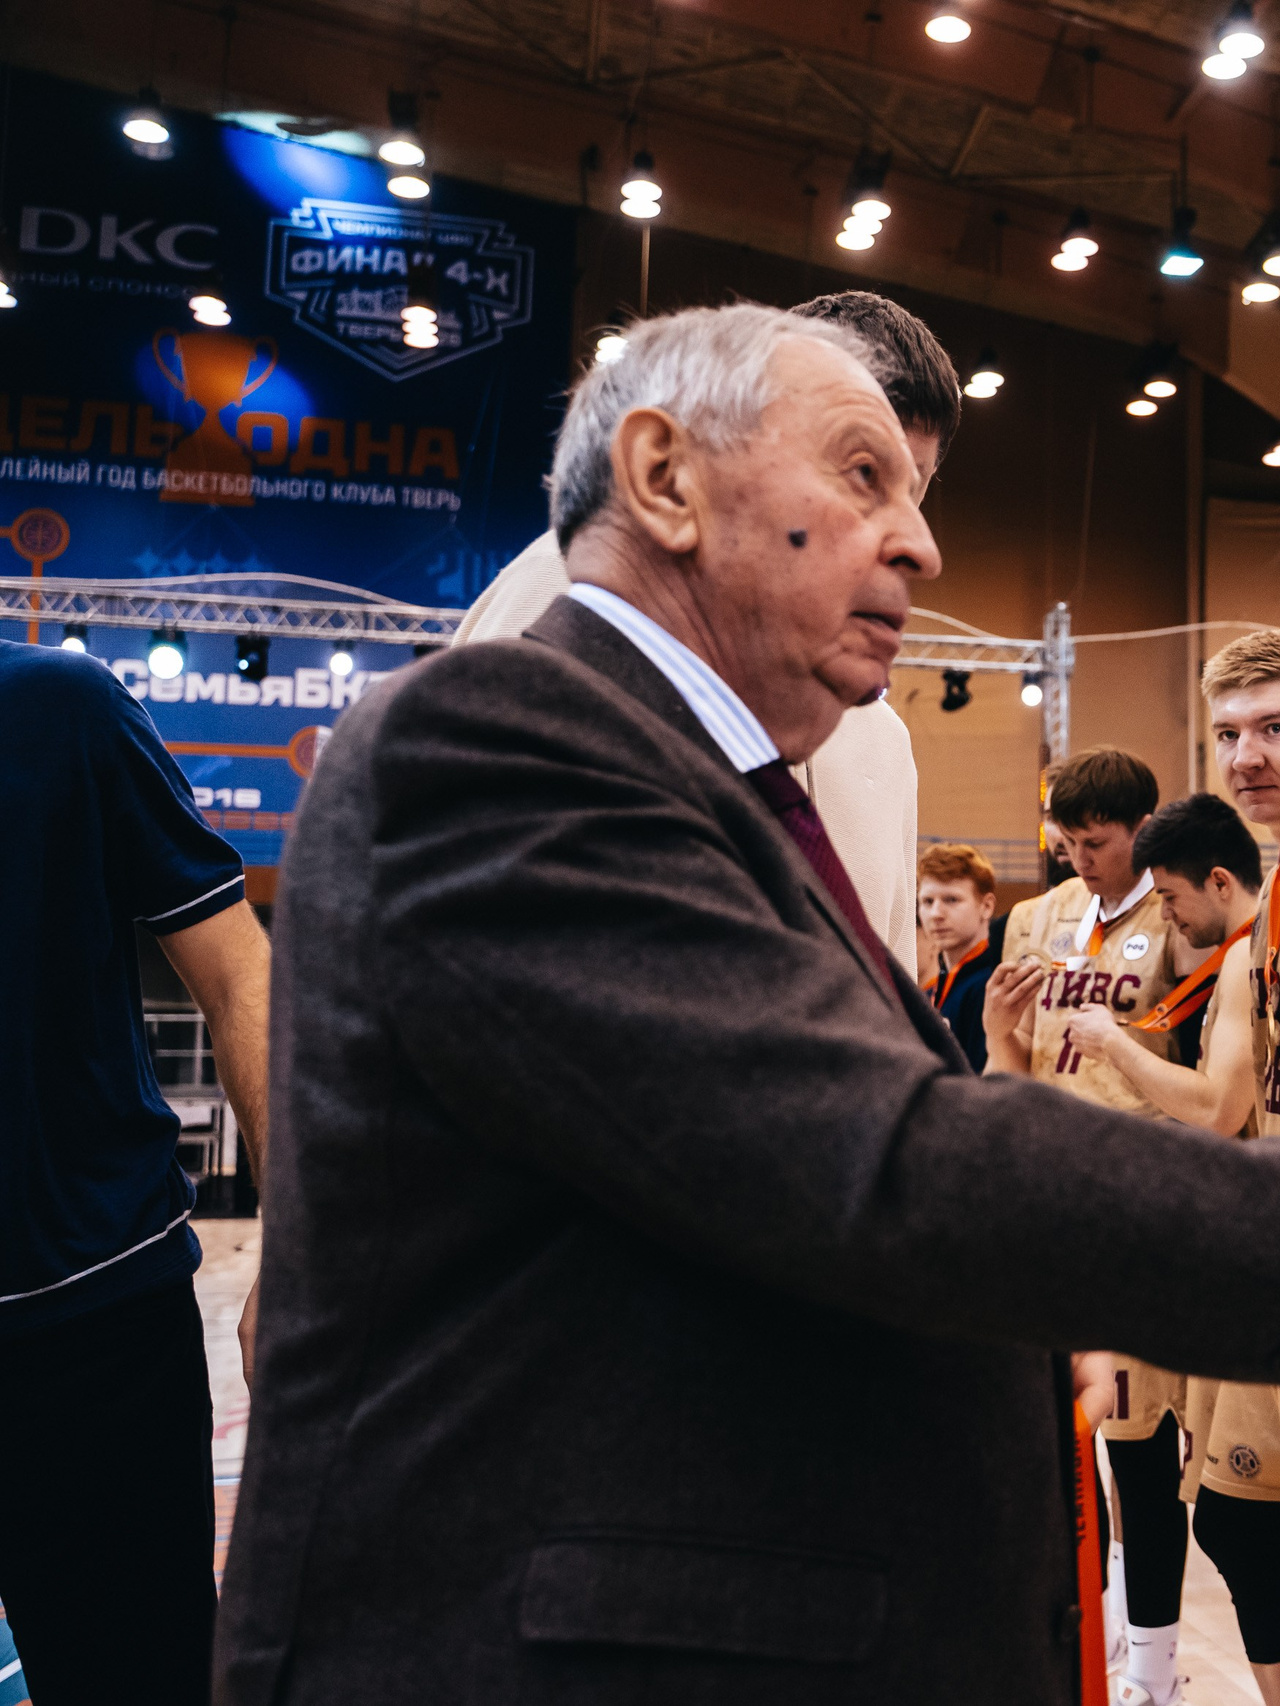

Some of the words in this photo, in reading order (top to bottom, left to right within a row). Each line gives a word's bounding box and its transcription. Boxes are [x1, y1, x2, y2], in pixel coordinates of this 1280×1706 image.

[18, 206, 220, 271] DKC
[236, 411, 461, 480] ОДНА
[97, 464, 137, 491] ГОД
[142, 468, 327, 503] БАСКЕТБОЛЬНОГО
[331, 482, 397, 507] КЛУБА
[401, 486, 462, 512] ТВЕРЬ
